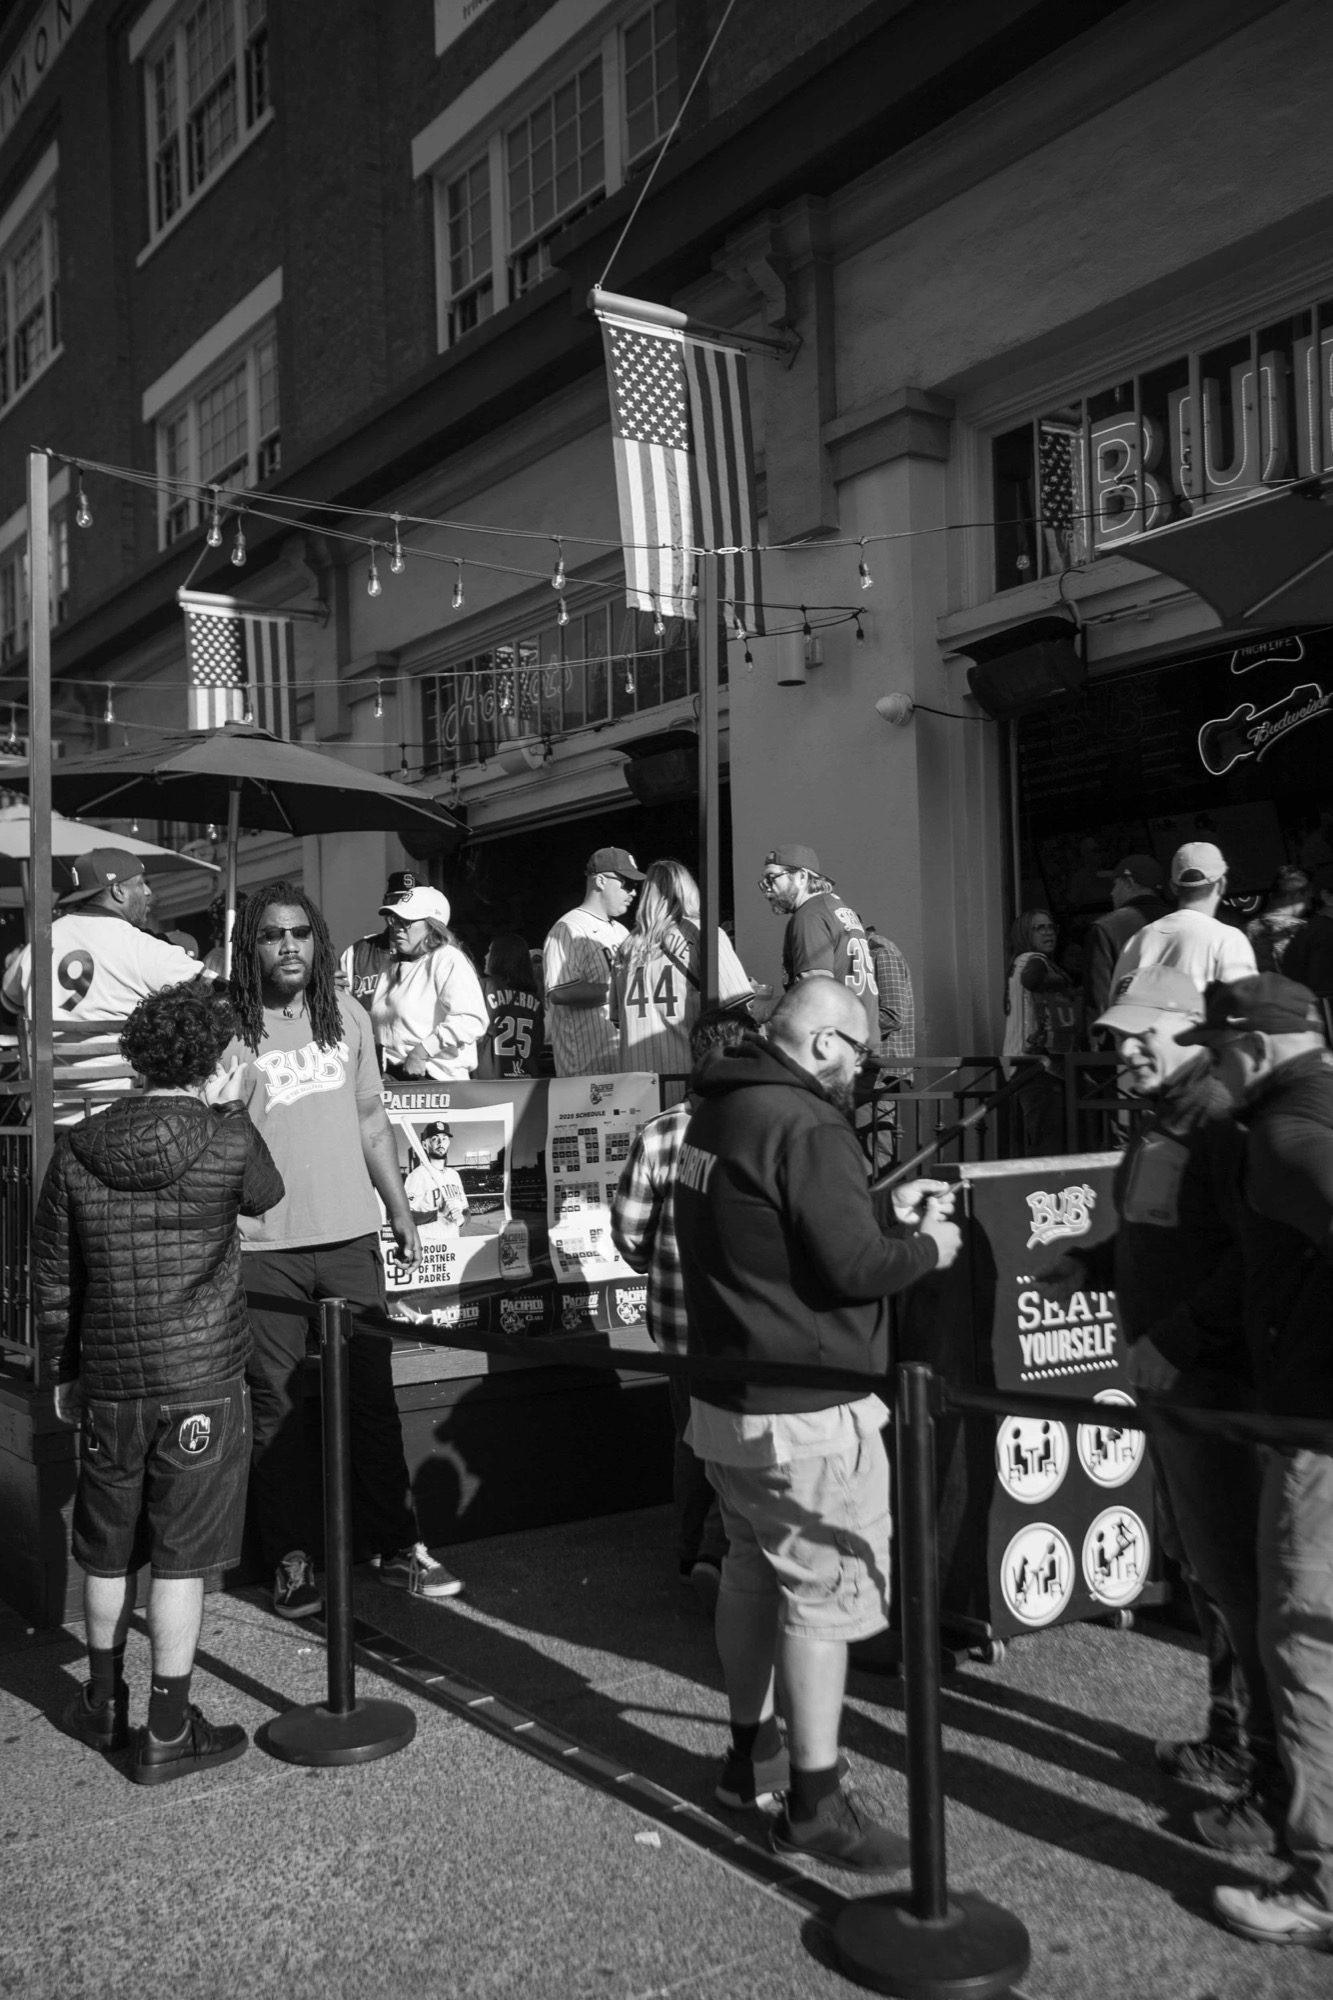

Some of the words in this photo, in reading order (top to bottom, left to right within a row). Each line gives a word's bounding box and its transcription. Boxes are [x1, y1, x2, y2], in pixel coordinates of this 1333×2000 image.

[1268, 637, 1293, 650] LIFE
[626, 964, 678, 1019] 44
[493, 1015, 534, 1059] 25
[380, 1090, 451, 1109] PACIFICO
[575, 1110, 606, 1119] SCHEDULE
[421, 1253, 456, 1265] ARTNER
[418, 1264, 429, 1274] OF
[431, 1263, 447, 1273] THE
[418, 1272, 451, 1284] PADRES
[500, 1299, 544, 1314] PACIFICO
[1017, 1290, 1116, 1331] SEAT
[1018, 1322, 1118, 1367] YOURSELF
